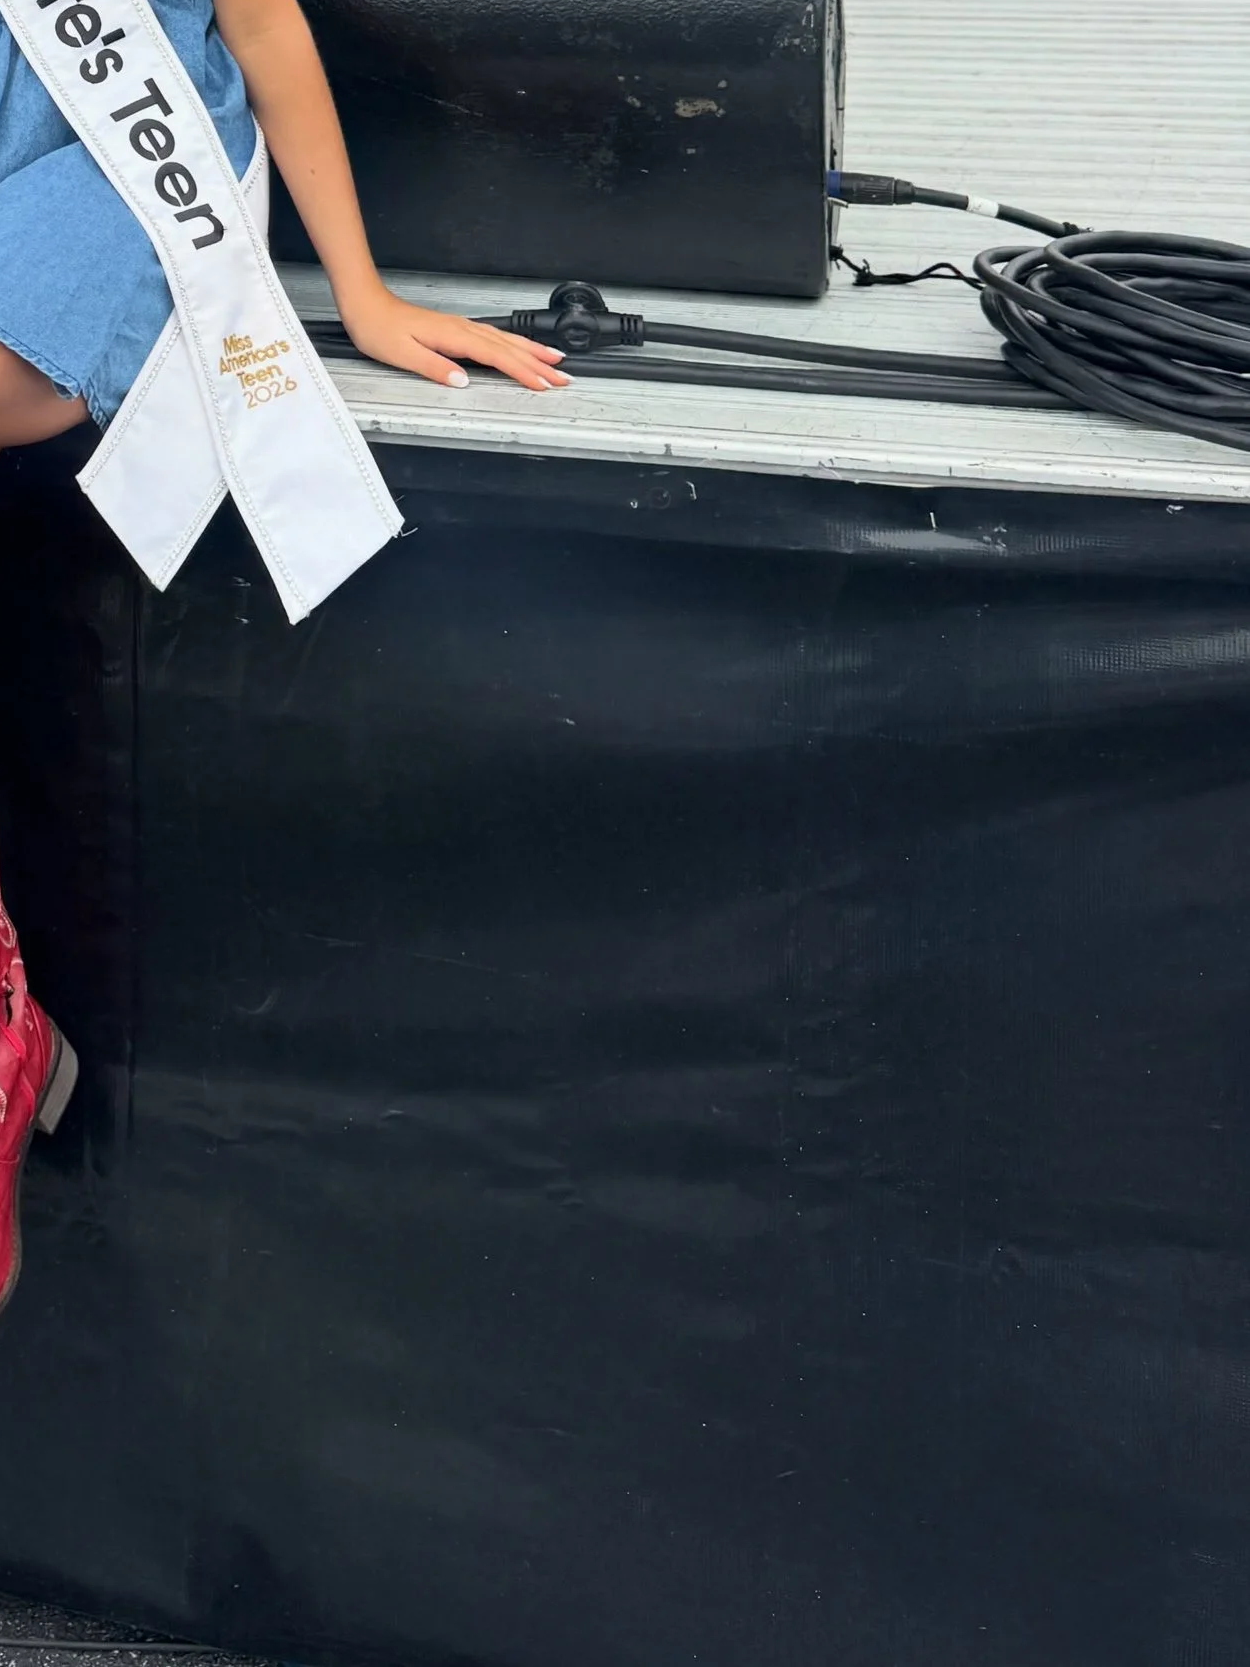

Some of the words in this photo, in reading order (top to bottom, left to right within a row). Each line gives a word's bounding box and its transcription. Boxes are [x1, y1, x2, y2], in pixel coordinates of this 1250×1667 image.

[110, 77, 226, 251] Teen
[219, 340, 291, 376] America's
[222, 334, 253, 356] Miss
[236, 364, 284, 389] Teen
[243, 376, 298, 409] 2026
